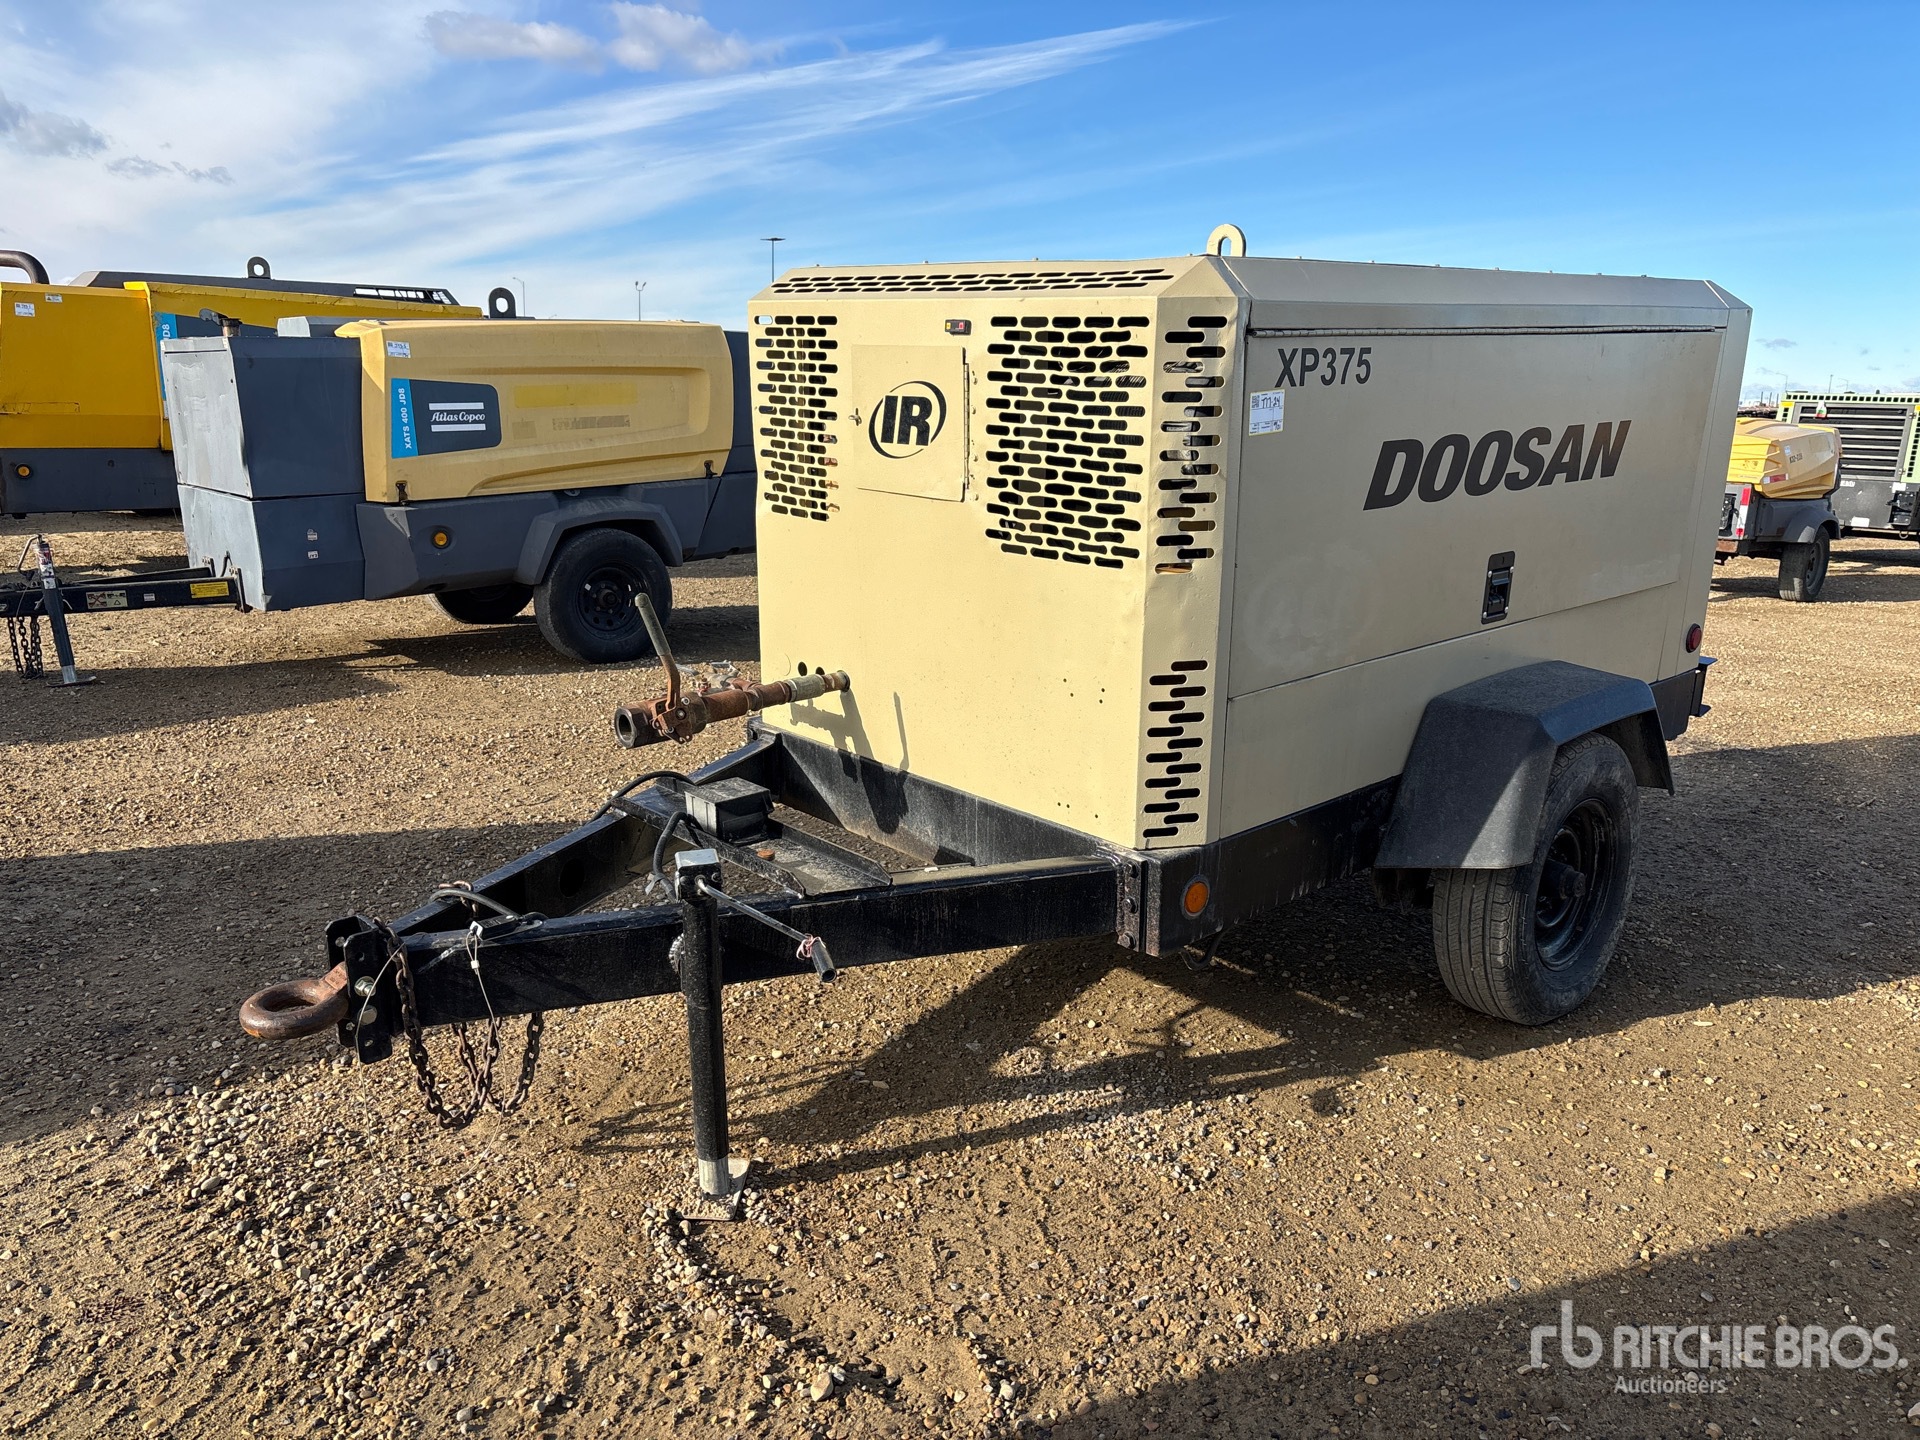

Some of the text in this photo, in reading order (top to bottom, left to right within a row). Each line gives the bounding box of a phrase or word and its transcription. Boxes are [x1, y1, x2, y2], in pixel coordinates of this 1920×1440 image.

[162, 324, 170, 340] D8
[1274, 347, 1372, 388] XP375
[398, 388, 412, 449] XATS 400 JD8
[431, 411, 486, 423] Atlas Copco
[880, 395, 932, 446] IR
[1363, 420, 1632, 510] DOOSAN
